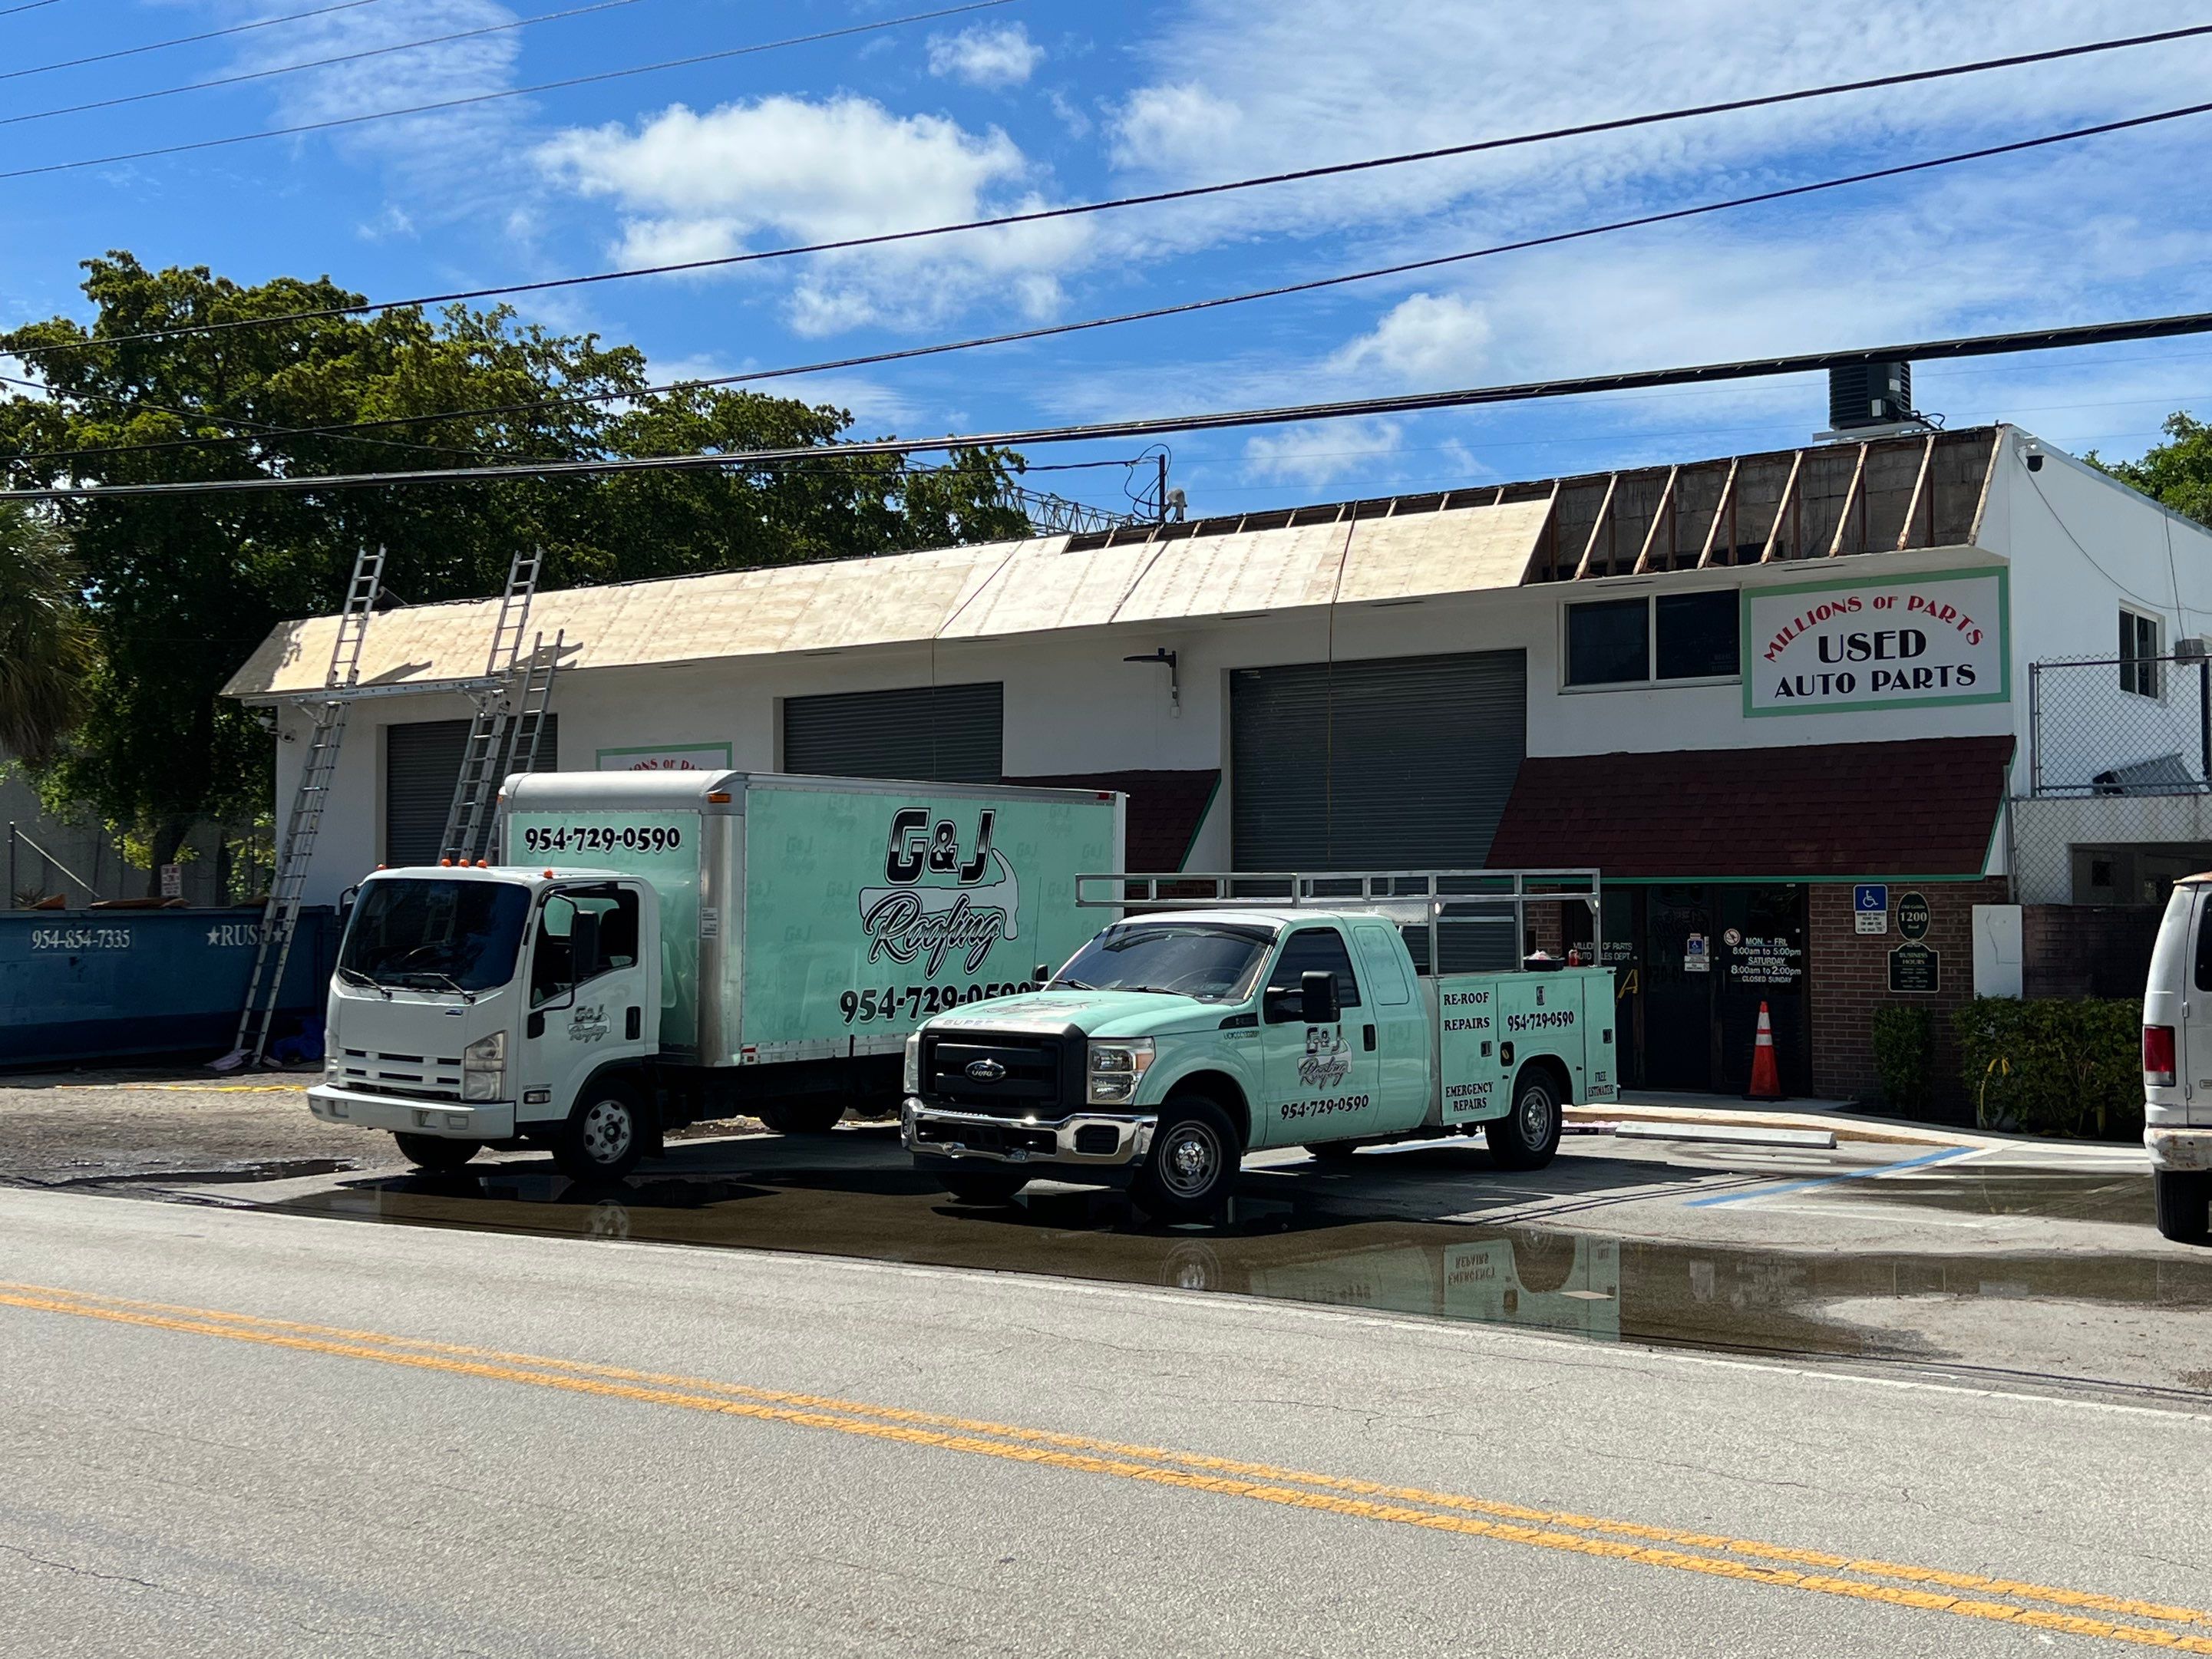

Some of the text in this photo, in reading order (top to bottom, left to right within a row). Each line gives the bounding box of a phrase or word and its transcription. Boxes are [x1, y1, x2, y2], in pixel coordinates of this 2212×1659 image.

[1764, 596, 1862, 663] MILLIONS
[1907, 595, 1984, 646] PARTS
[1818, 628, 1926, 664] USED
[1775, 664, 1976, 698] AUTO PARTS
[524, 826, 681, 853] 954-729-0590
[884, 806, 996, 886] G&J
[1900, 912, 1927, 922] 1200
[31, 929, 130, 949] 954-854-7335
[863, 890, 1004, 980] Roofing
[1573, 942, 1595, 950] MILLIO
[1613, 942, 1633, 952] PARTS
[1732, 947, 1760, 955] 8:00am
[1773, 948, 1801, 957] 5:00pm
[1731, 965, 1760, 974] 8:00am
[1771, 966, 1801, 976] 2:00pm
[1748, 957, 1785, 965] SATURDAY
[1443, 991, 1490, 1006] RE-ROOF
[1444, 1017, 1491, 1031] REPAIRS
[1507, 1011, 1574, 1032] 954-729-0590
[1306, 1024, 1342, 1055] G&J
[1445, 1081, 1494, 1098] EMERGENCY
[1281, 1094, 1369, 1120] 954-729-0590
[1453, 1097, 1487, 1113] REPAIRS
